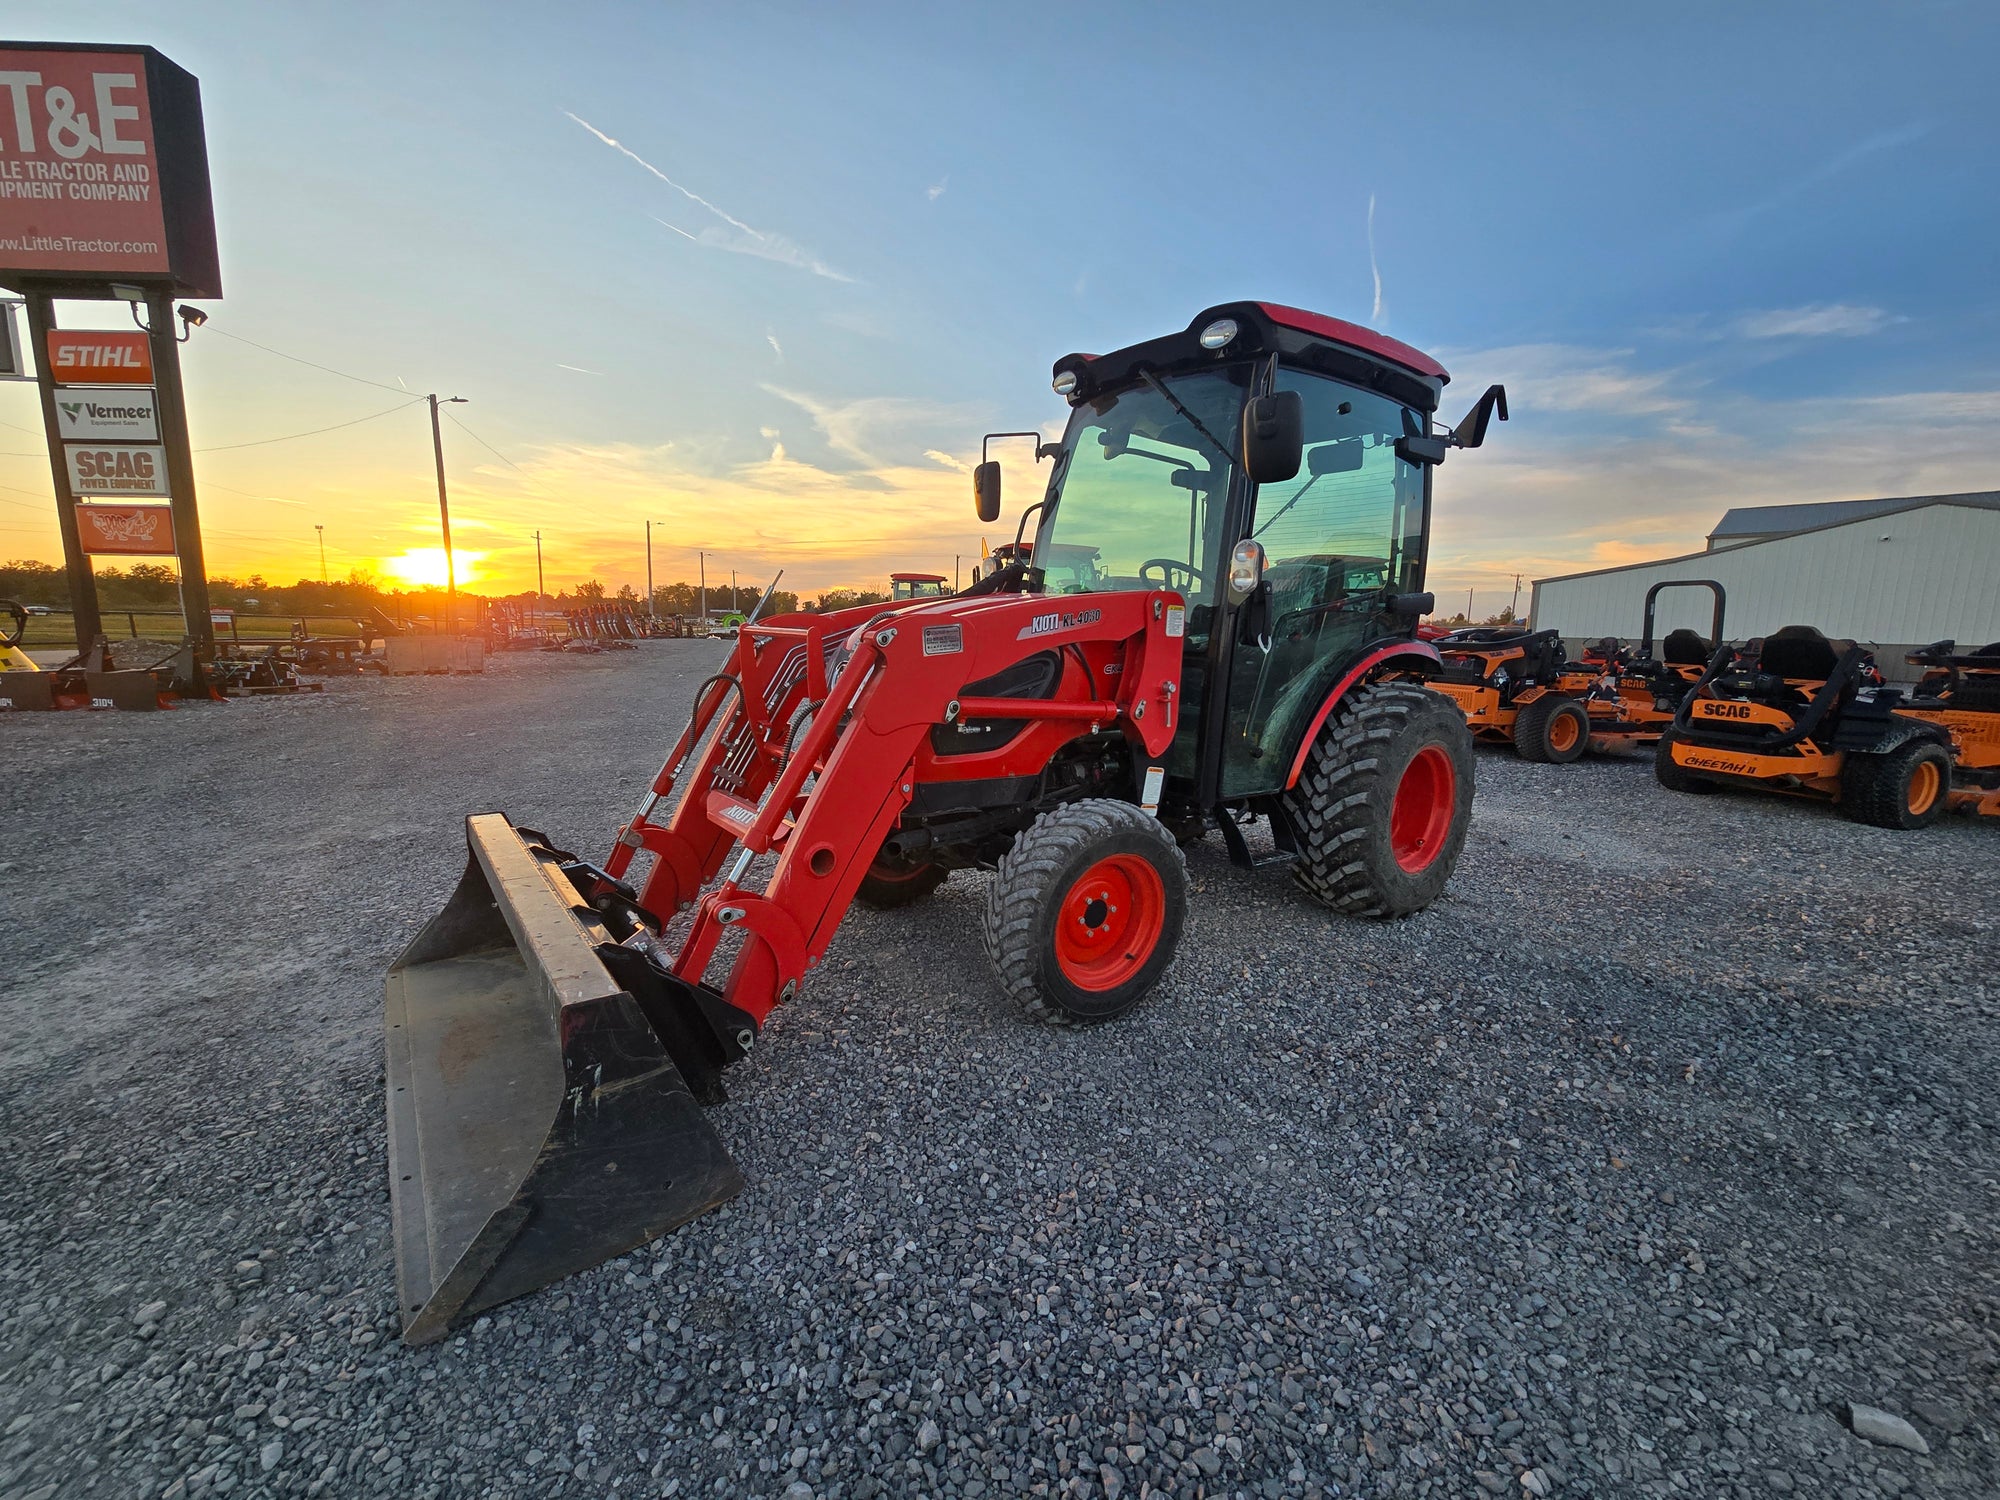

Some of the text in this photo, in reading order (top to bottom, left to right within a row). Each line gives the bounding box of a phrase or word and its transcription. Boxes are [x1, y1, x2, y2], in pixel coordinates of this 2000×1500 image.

[0, 71, 146, 159] T&E
[0, 161, 149, 182] LE TRACTOR AND
[0, 181, 150, 201] IPMENT COMPANY
[56, 345, 141, 367] STIHL
[85, 403, 152, 418] Vermeer
[76, 451, 154, 478] SCAG
[80, 479, 155, 490] POWER EQUIPMENT
[1031, 613, 1059, 634] KIOTI
[1621, 679, 1646, 688] SCAG
[92, 698, 113, 706] 3104
[1704, 704, 1750, 718] SCAG
[1684, 757, 1757, 775] CHEETAH II
[727, 804, 757, 824] KIOTI
